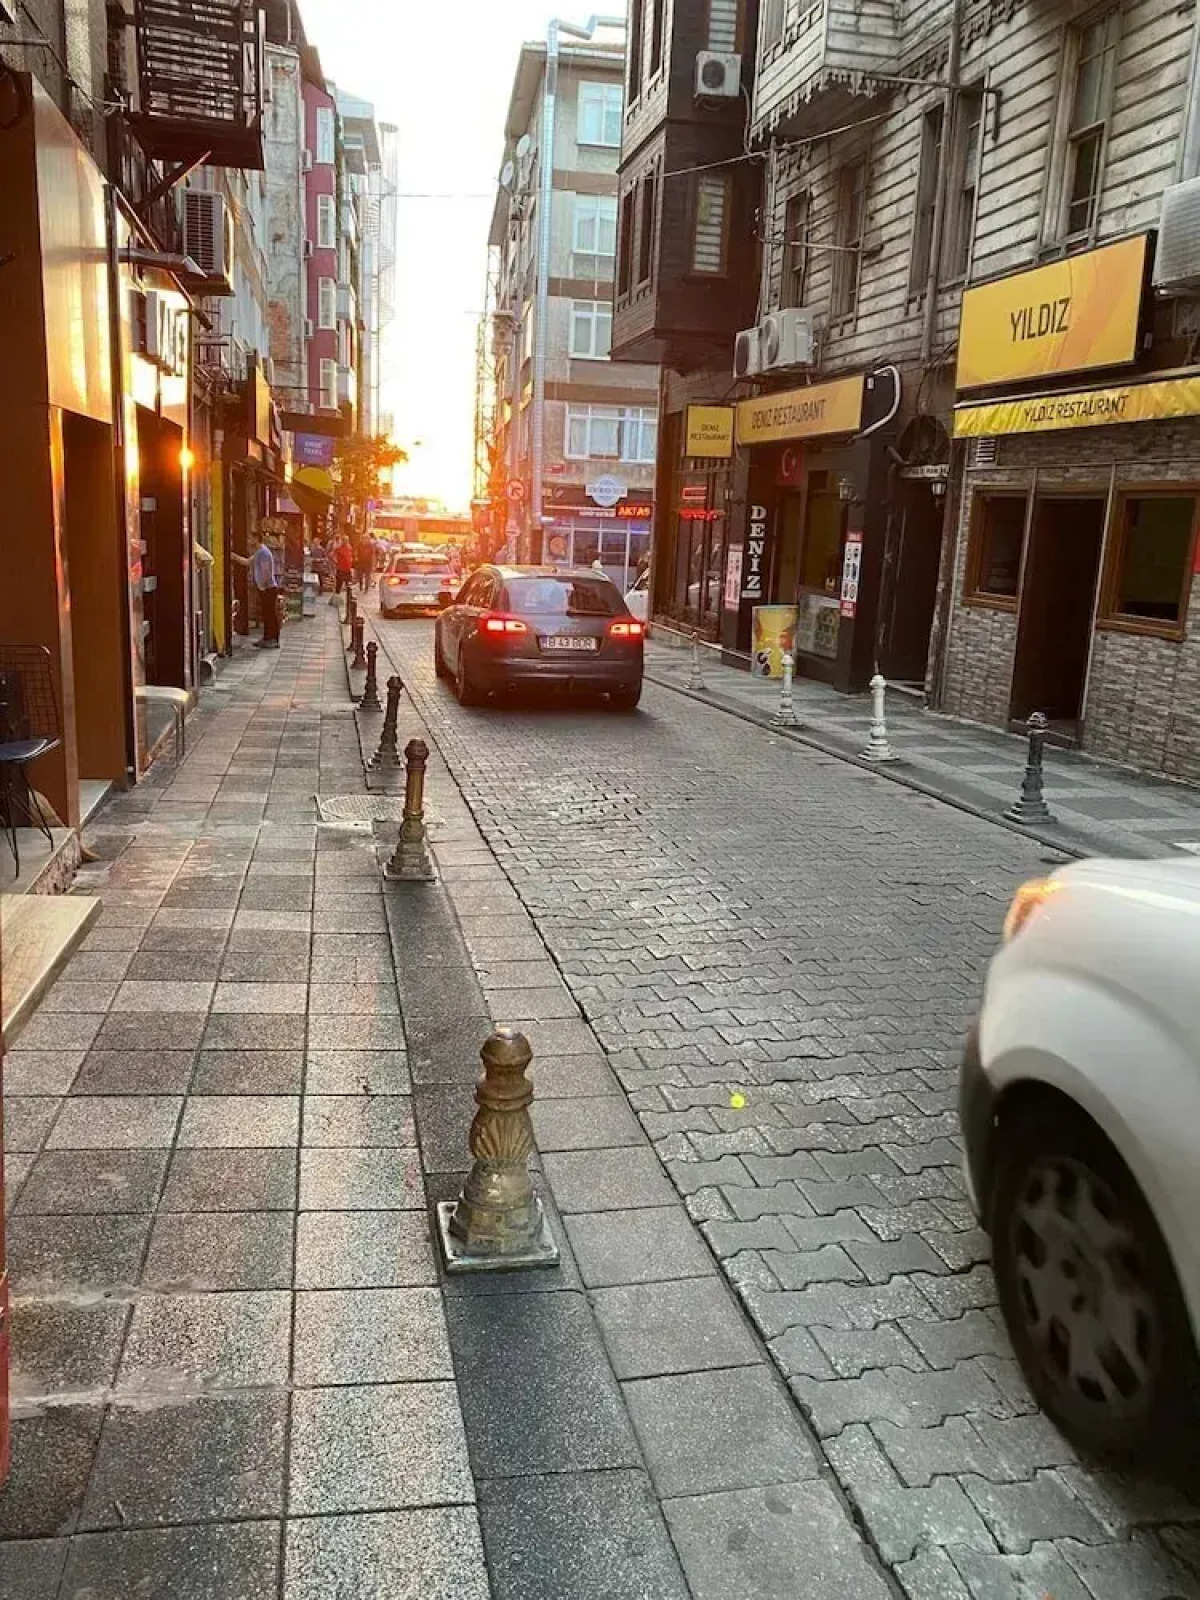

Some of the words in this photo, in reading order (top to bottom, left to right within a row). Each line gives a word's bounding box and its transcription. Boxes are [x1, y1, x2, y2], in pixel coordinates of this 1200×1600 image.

[1010, 297, 1070, 342] YILDIZ
[773, 398, 827, 427] RESTAURANT
[1023, 403, 1055, 422] YILDIZ
[1056, 393, 1130, 419] RESTAURANT
